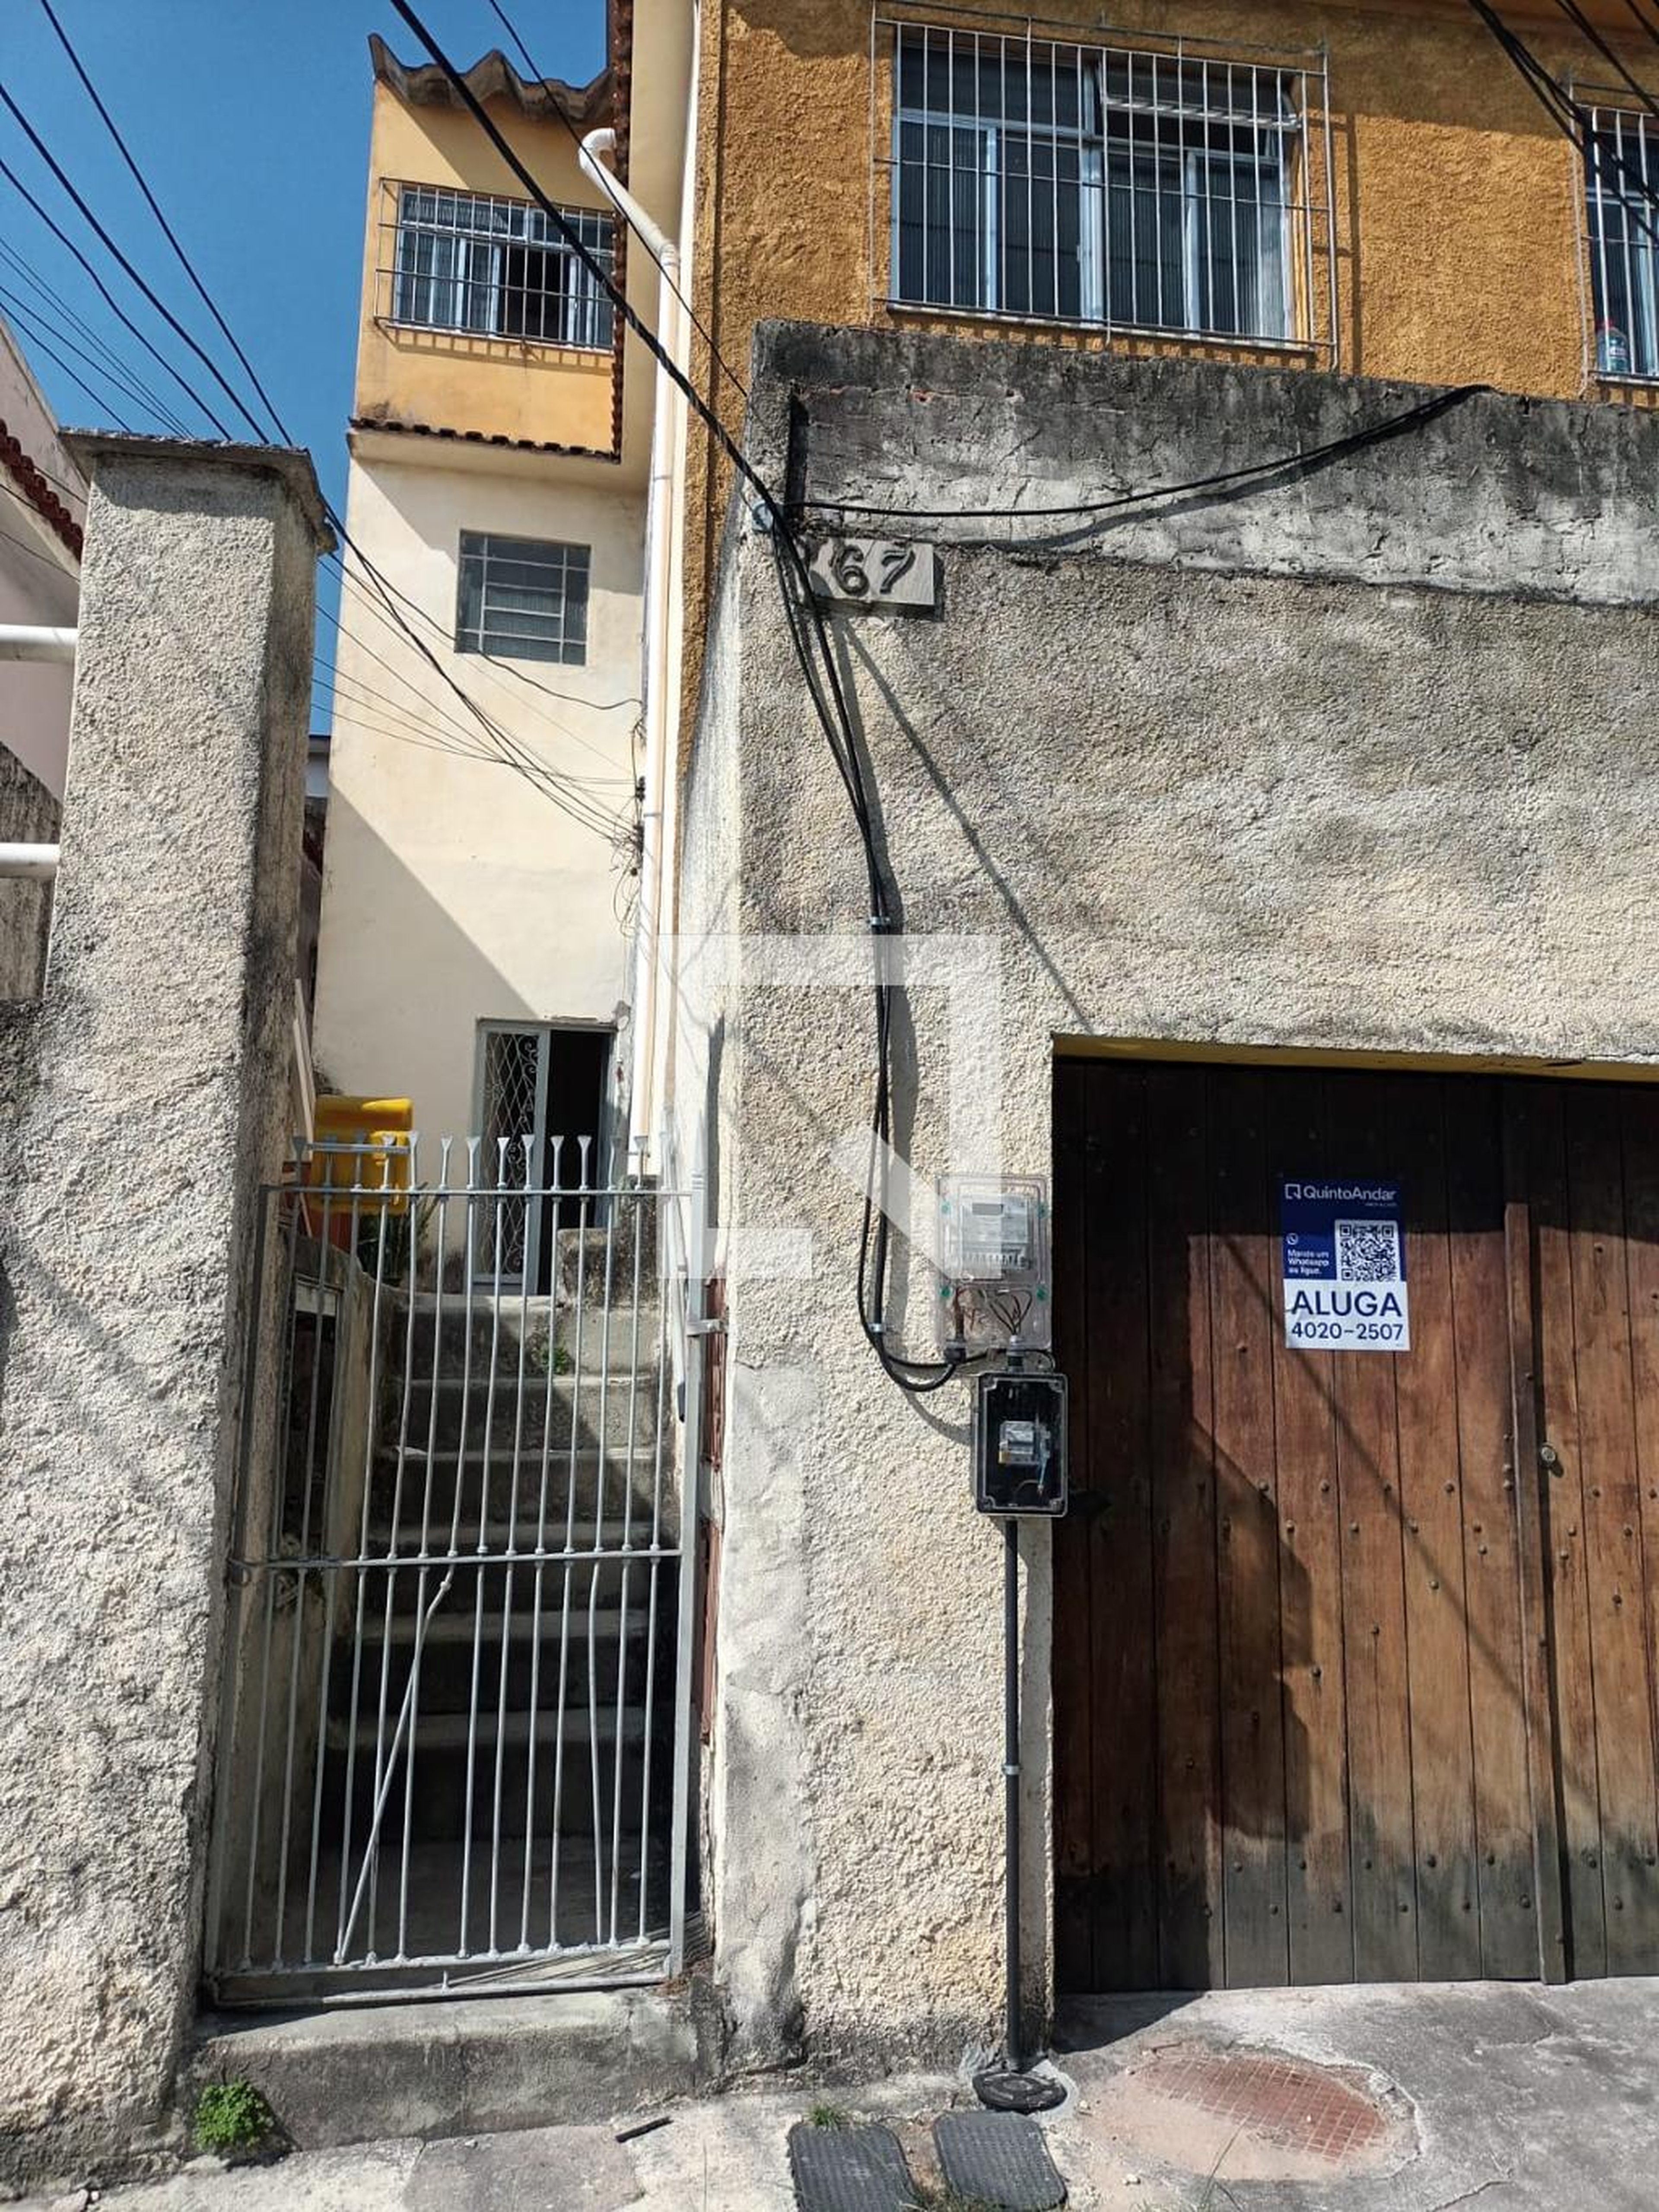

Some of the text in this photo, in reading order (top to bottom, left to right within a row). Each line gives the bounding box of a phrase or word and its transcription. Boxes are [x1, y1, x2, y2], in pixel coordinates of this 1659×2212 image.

[831, 544, 916, 598] 67
[1303, 1185, 1397, 1201] QuintoAndar
[1291, 1291, 1402, 1317] ALUGA
[1292, 1322, 1403, 1340] 4020-2507
